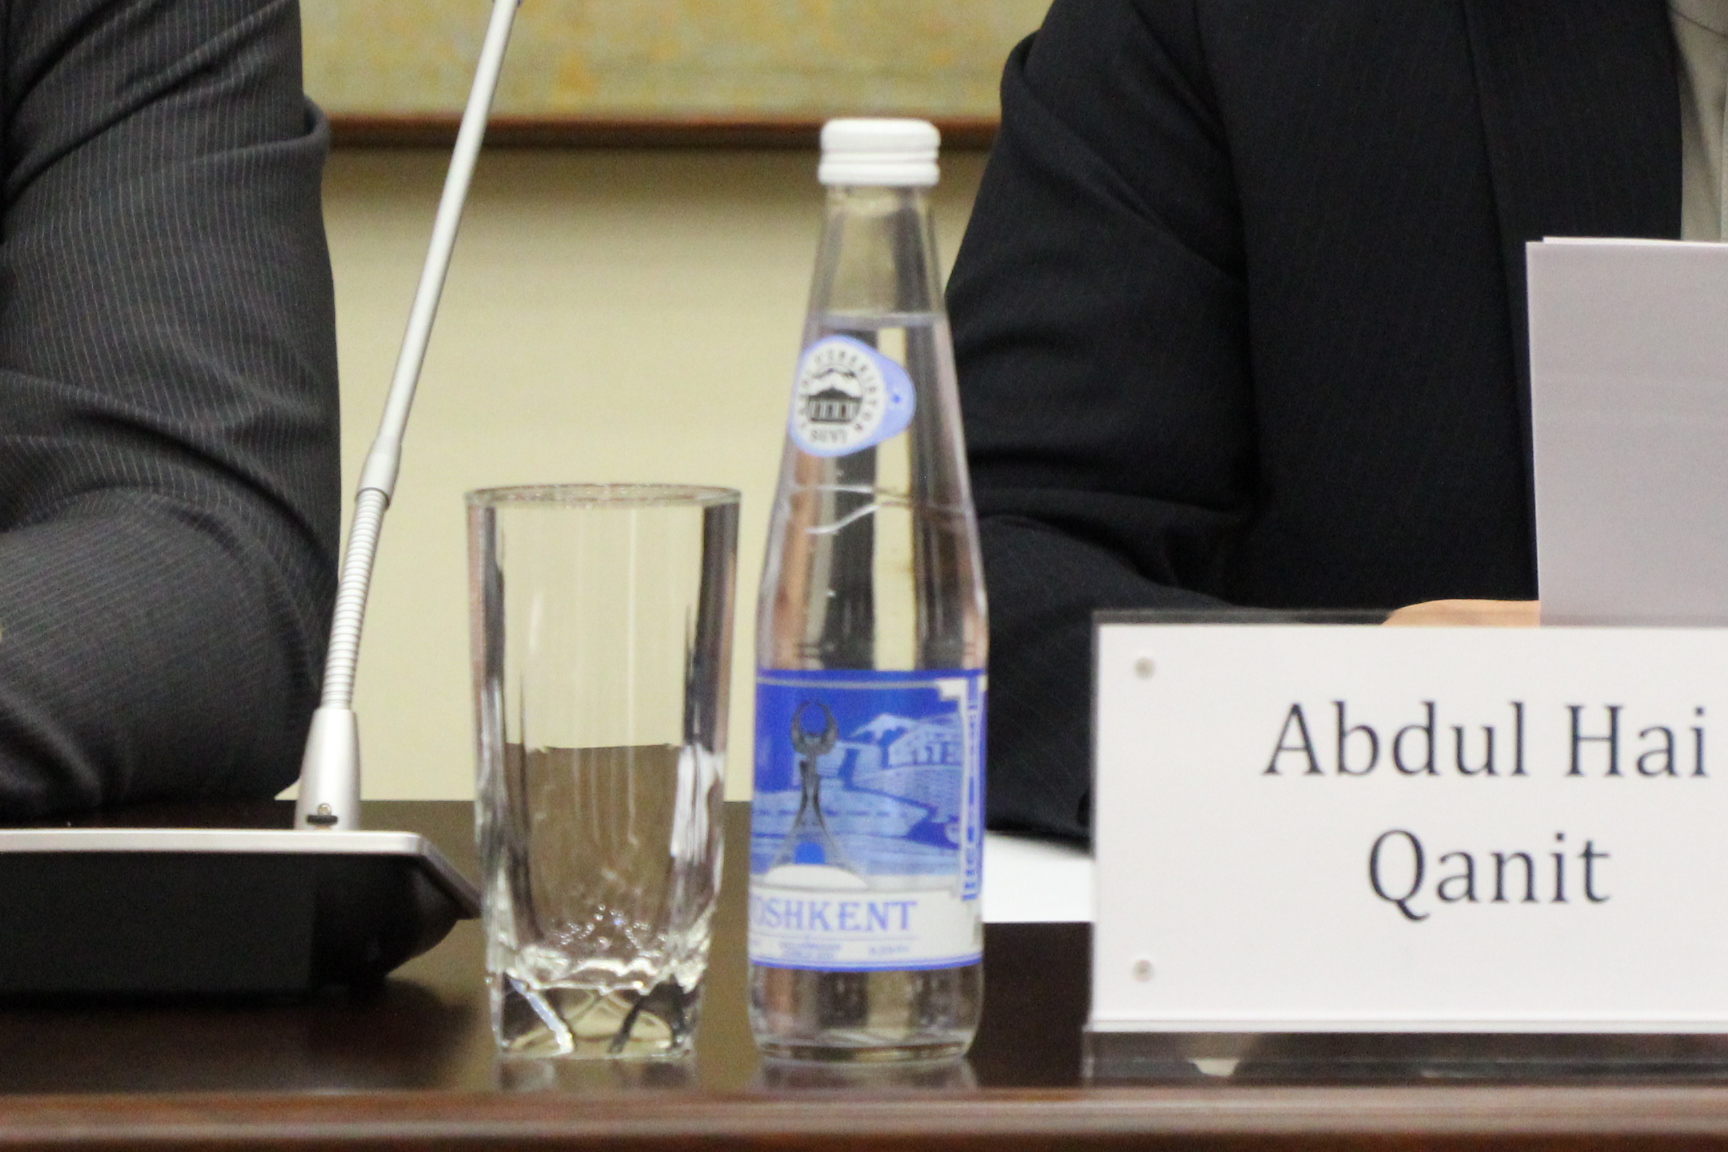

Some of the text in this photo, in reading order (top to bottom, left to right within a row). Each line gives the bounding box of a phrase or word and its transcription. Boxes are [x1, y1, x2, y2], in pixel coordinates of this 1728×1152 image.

[1262, 700, 1712, 778] Abdul Hai
[1368, 828, 1612, 922] Qanit
